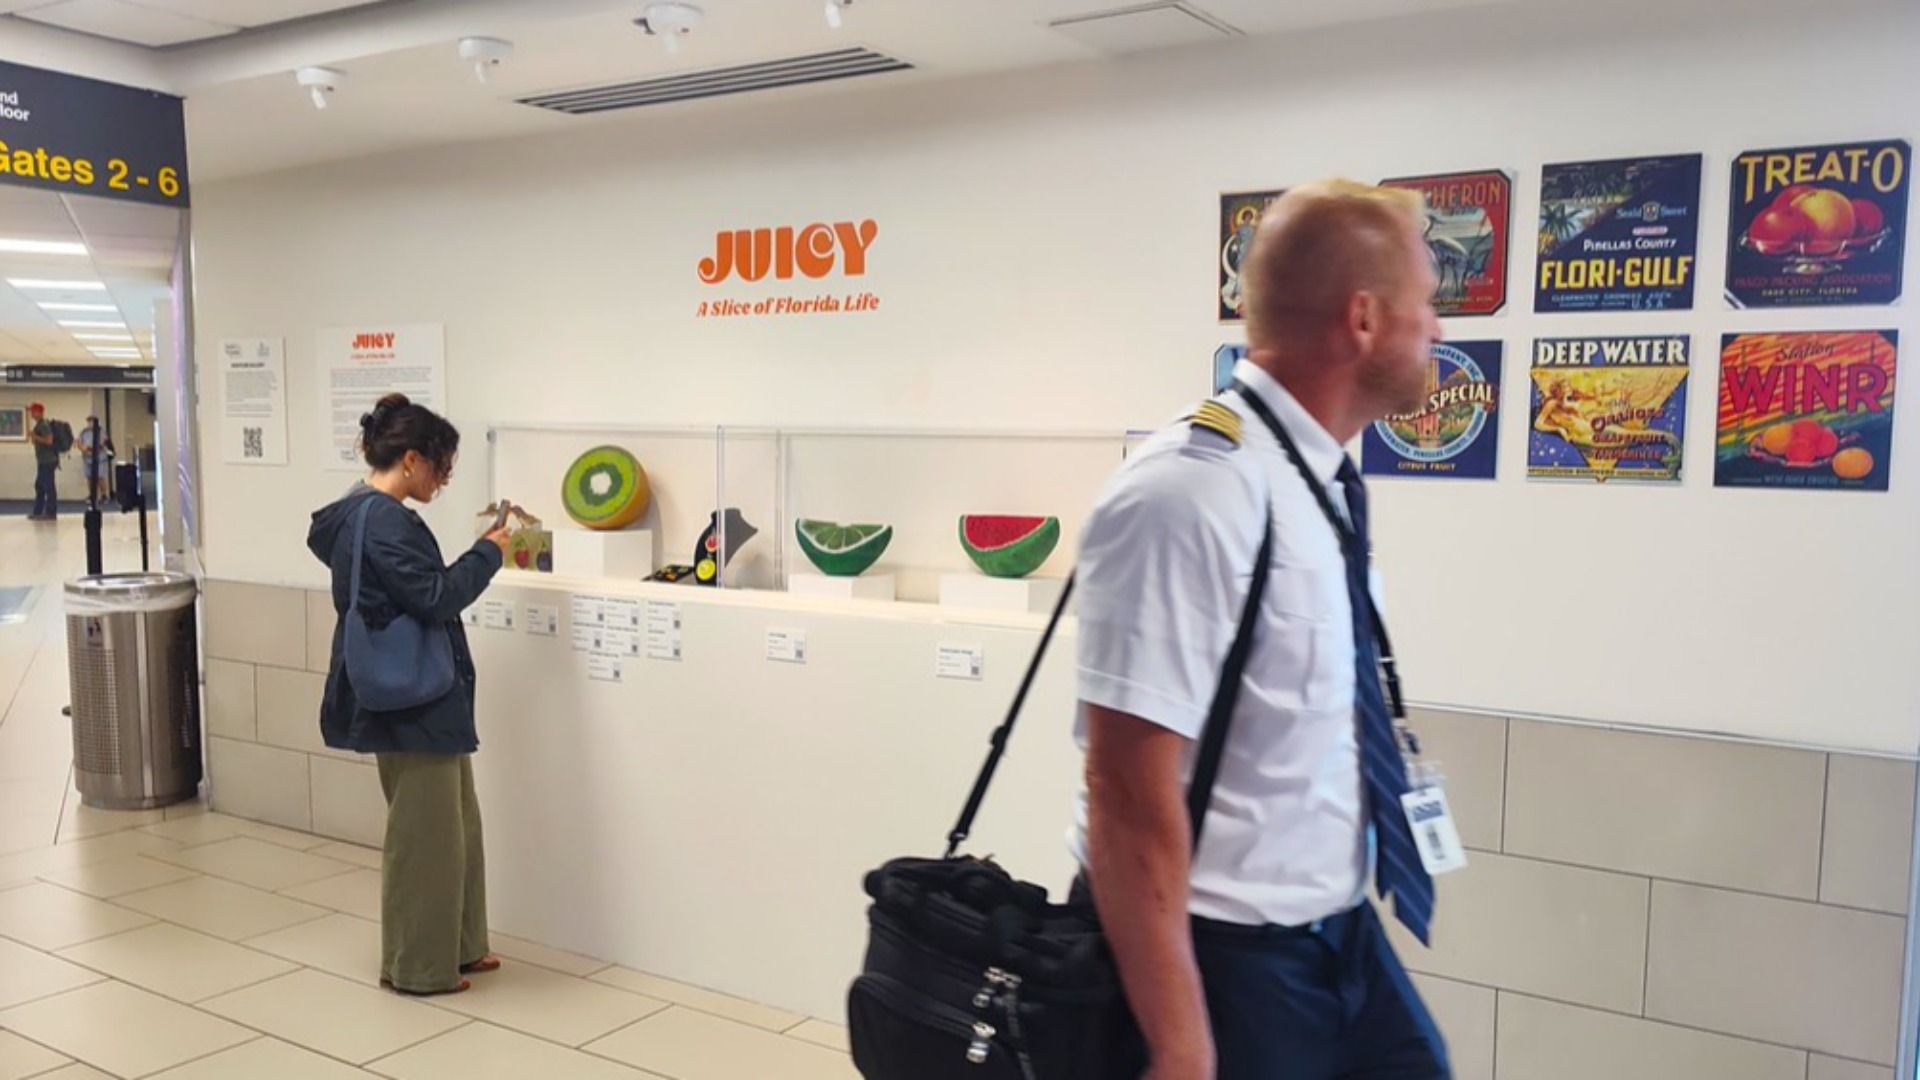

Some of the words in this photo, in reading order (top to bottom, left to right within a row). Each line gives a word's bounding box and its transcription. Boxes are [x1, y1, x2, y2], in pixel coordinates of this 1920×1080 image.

[107, 158, 129, 190] 2
[158, 166, 179, 197] 6
[1738, 147, 1903, 204] TREAT-O
[697, 219, 878, 284] JUICY
[697, 301, 708, 317] A
[710, 298, 751, 317] Slice
[754, 296, 775, 315] of
[775, 294, 840, 314] Florida
[842, 292, 880, 312] Life
[352, 332, 395, 350] JUICY
[1536, 340, 1599, 365] DEEP
[1601, 339, 1686, 364] WATER
[1429, 383, 1494, 414] SPECIAL
[1723, 363, 1888, 415] WINR
